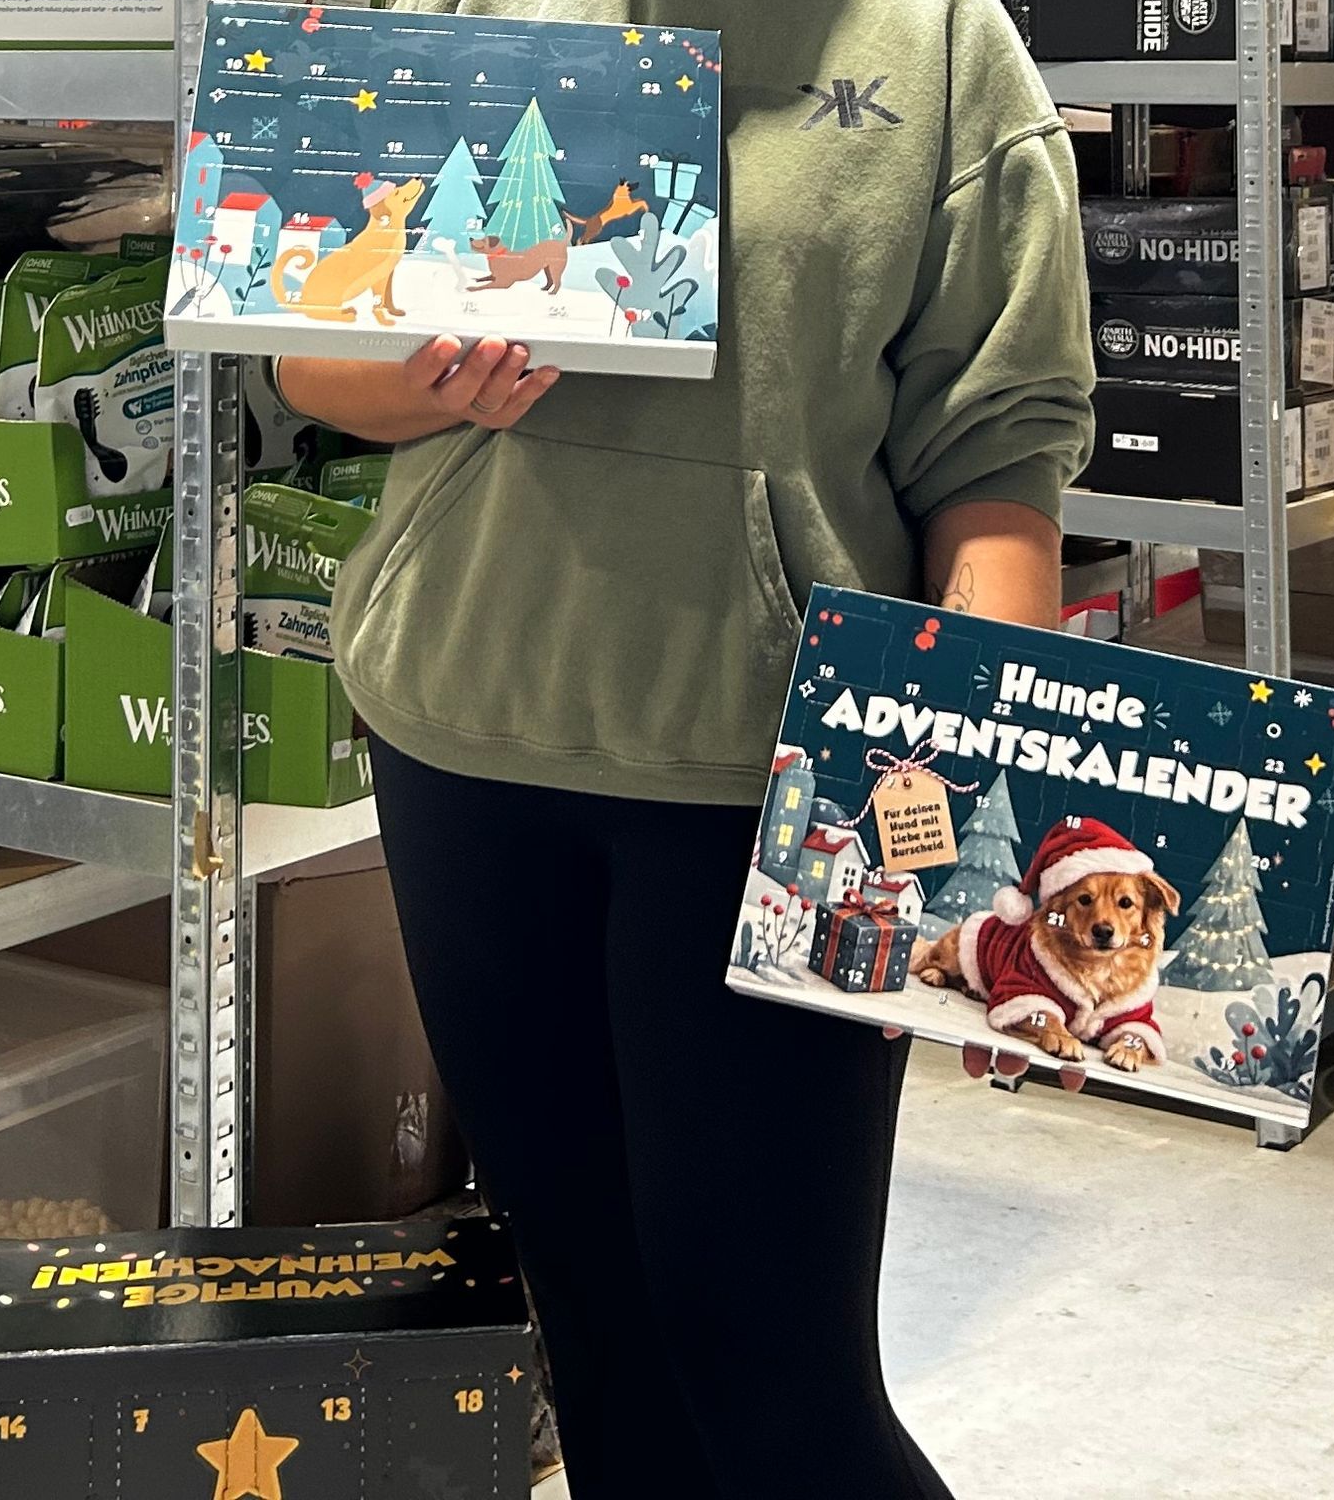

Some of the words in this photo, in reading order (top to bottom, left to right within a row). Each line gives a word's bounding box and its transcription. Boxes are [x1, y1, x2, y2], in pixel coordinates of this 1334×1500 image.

[62, 301, 165, 353] WHIMZEES
[333, 463, 361, 476] OHNE
[999, 662, 1146, 729] Hunde
[821, 687, 1312, 829] ADVENTSKALENDER
[904, 802, 942, 817] deinen
[890, 819, 918, 833] Hund
[921, 815, 940, 826] mit
[891, 832, 921, 845] Liebe
[923, 828, 943, 840] aus
[890, 840, 944, 858] Burscheid
[30, 1247, 457, 1290] WEIHNACHTEN!
[122, 1276, 366, 1309] WUFFIGE
[320, 1397, 353, 1422] 13
[453, 1389, 484, 1413] 18
[132, 1408, 150, 1432] 7
